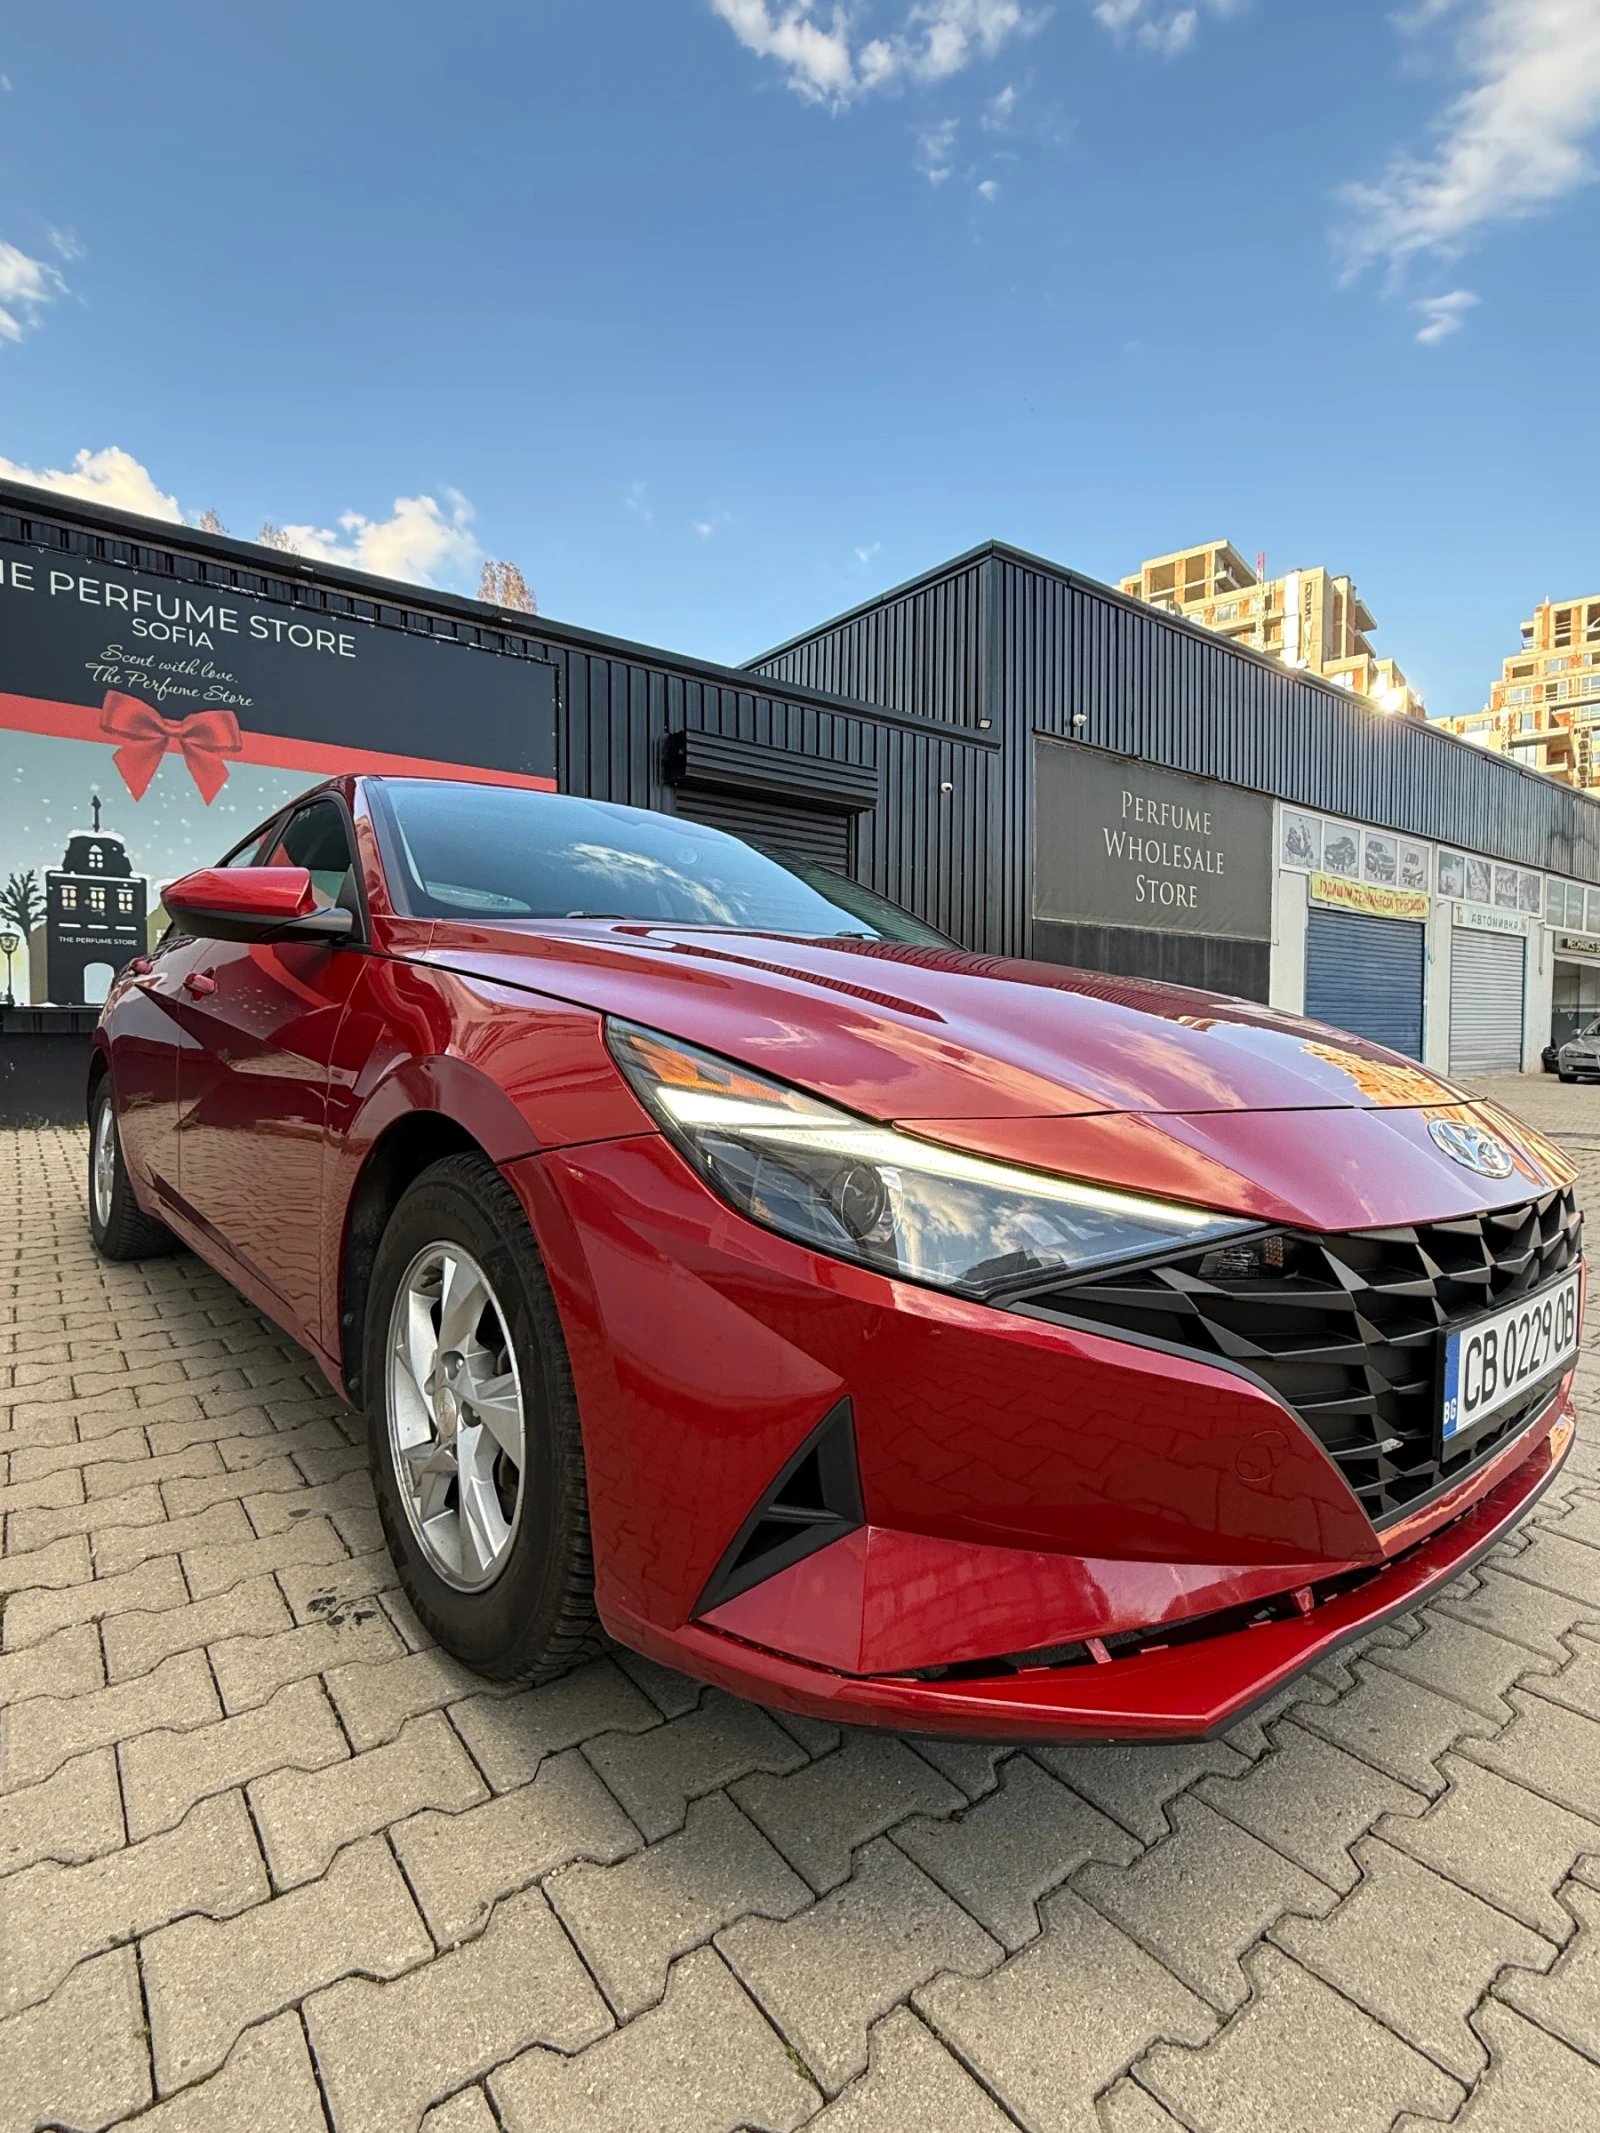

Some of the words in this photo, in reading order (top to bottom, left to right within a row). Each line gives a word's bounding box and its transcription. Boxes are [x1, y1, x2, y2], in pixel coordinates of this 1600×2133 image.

[0, 559, 35, 591] E
[50, 571, 239, 634] PERFUME
[250, 615, 357, 658] STORE
[132, 618, 214, 650] SOFIA
[100, 644, 156, 667] Scent
[158, 658, 198, 675] with
[201, 662, 239, 683] love.
[85, 662, 123, 684] The
[124, 670, 201, 700] Perfume
[203, 685, 255, 707] Store
[1121, 790, 1212, 835] PERFUME
[1103, 827, 1224, 875] WHOLESALE
[1135, 874, 1198, 908] STORE
[76, 937, 113, 945] PERFUME
[113, 938, 138, 946] STORE
[1471, 913, 1518, 931] АВТОМИВКА
[1463, 1328, 1498, 1413] CB
[1503, 1298, 1553, 1389] 0229
[1443, 1398, 1457, 1425] BG
